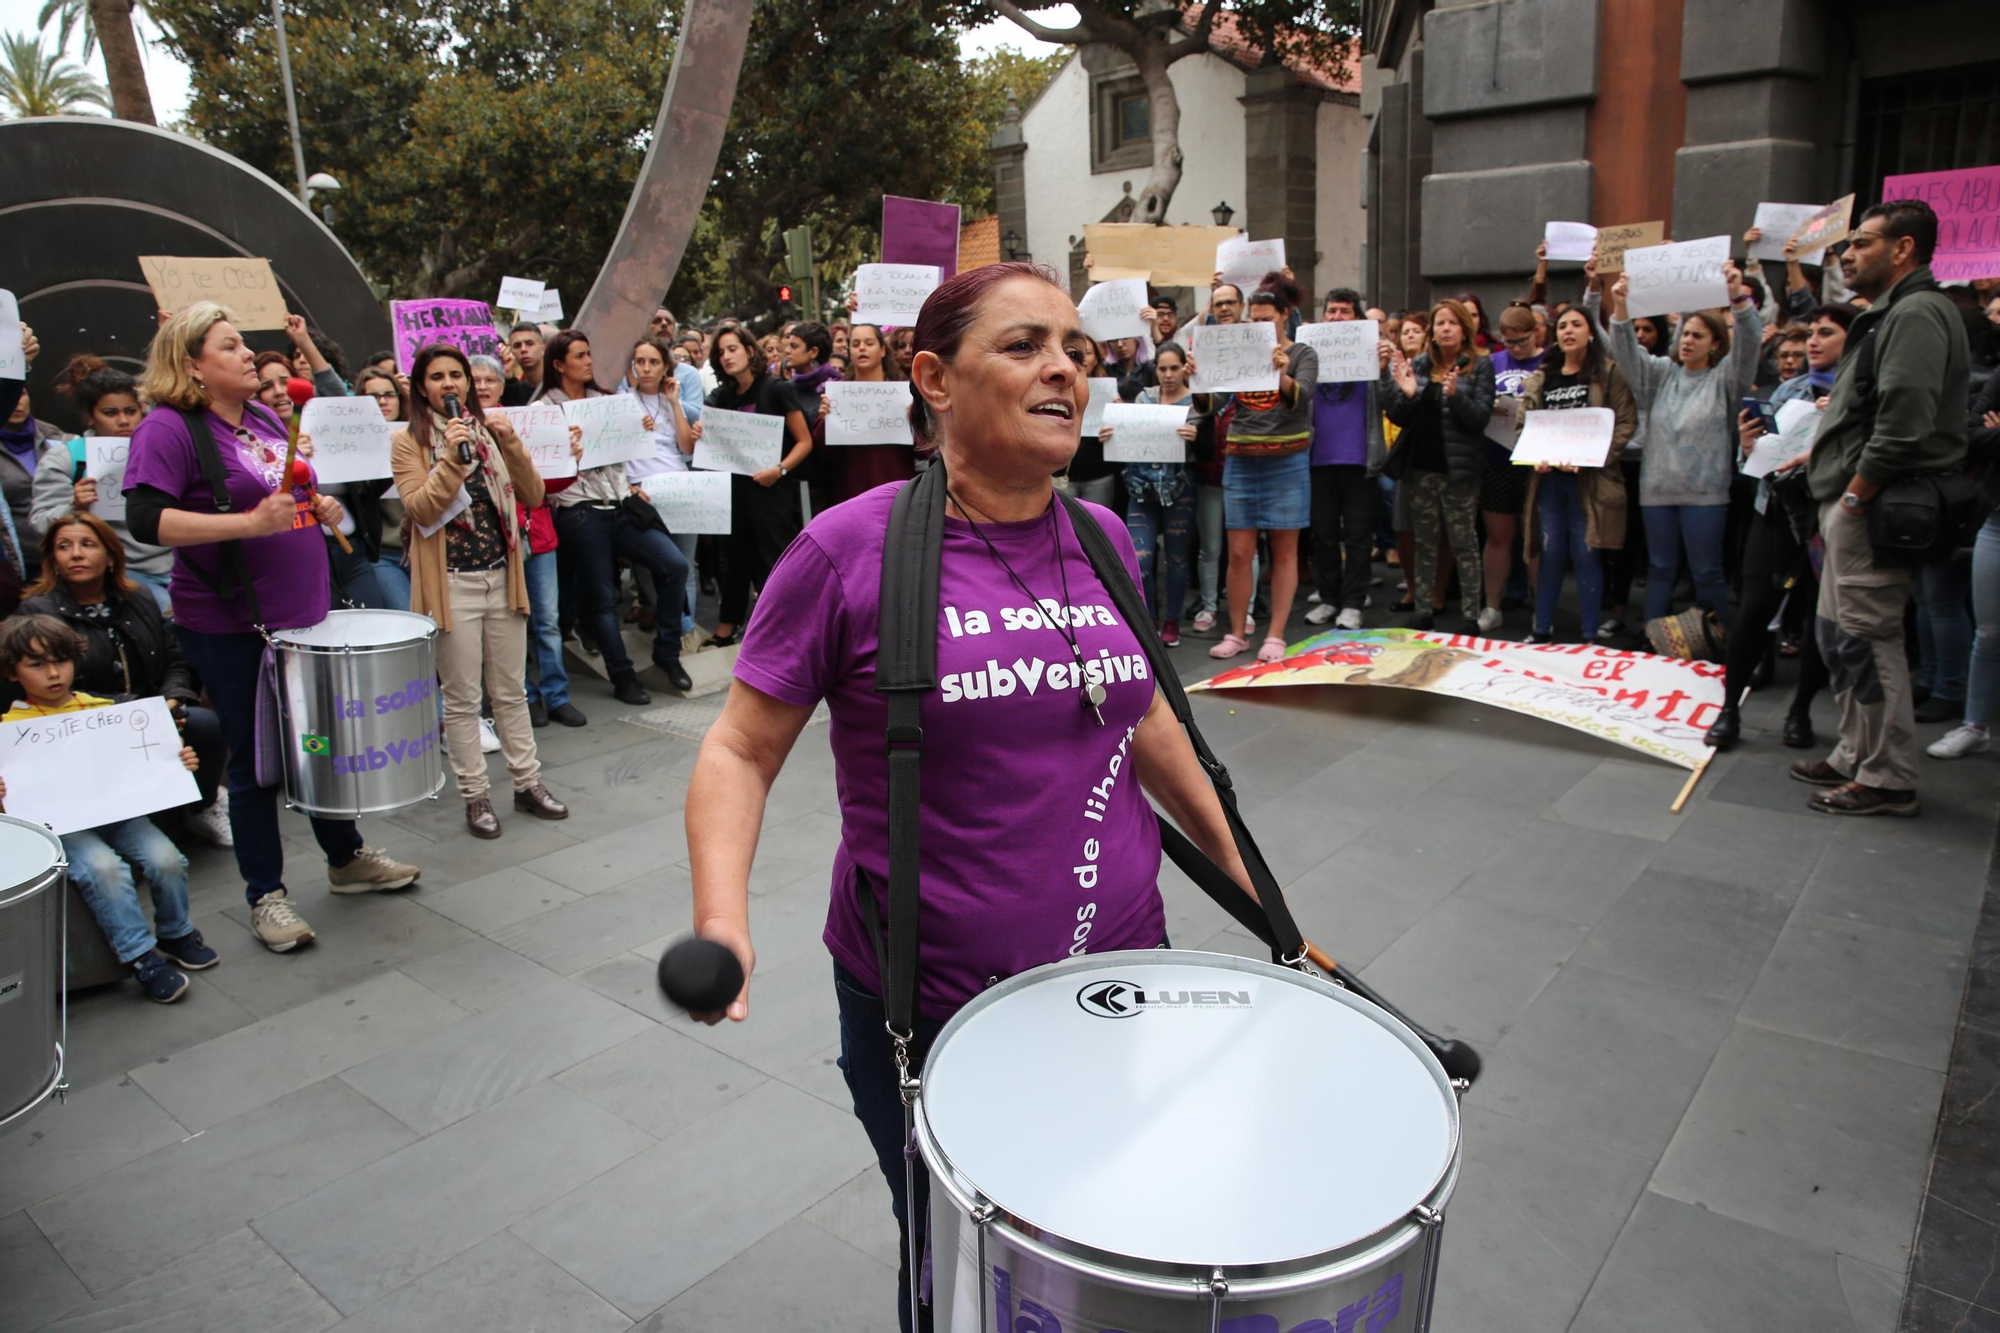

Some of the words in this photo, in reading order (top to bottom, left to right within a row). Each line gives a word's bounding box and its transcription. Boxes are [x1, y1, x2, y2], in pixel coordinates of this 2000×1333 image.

[1216, 347, 1240, 363] ES
[1318, 351, 1356, 363] OTRAS
[1317, 367, 1368, 379] LTITUD
[601, 420, 622, 433] AL
[840, 417, 860, 431] TE
[868, 417, 905, 429] CREO
[944, 605, 992, 638] la
[1000, 598, 1119, 631] soRora
[941, 648, 1148, 703] subVersiva
[1583, 660, 1635, 681] el
[334, 694, 366, 720] la
[85, 711, 123, 731] CREO
[1084, 714, 1145, 822] libert
[1073, 838, 1100, 889] de
